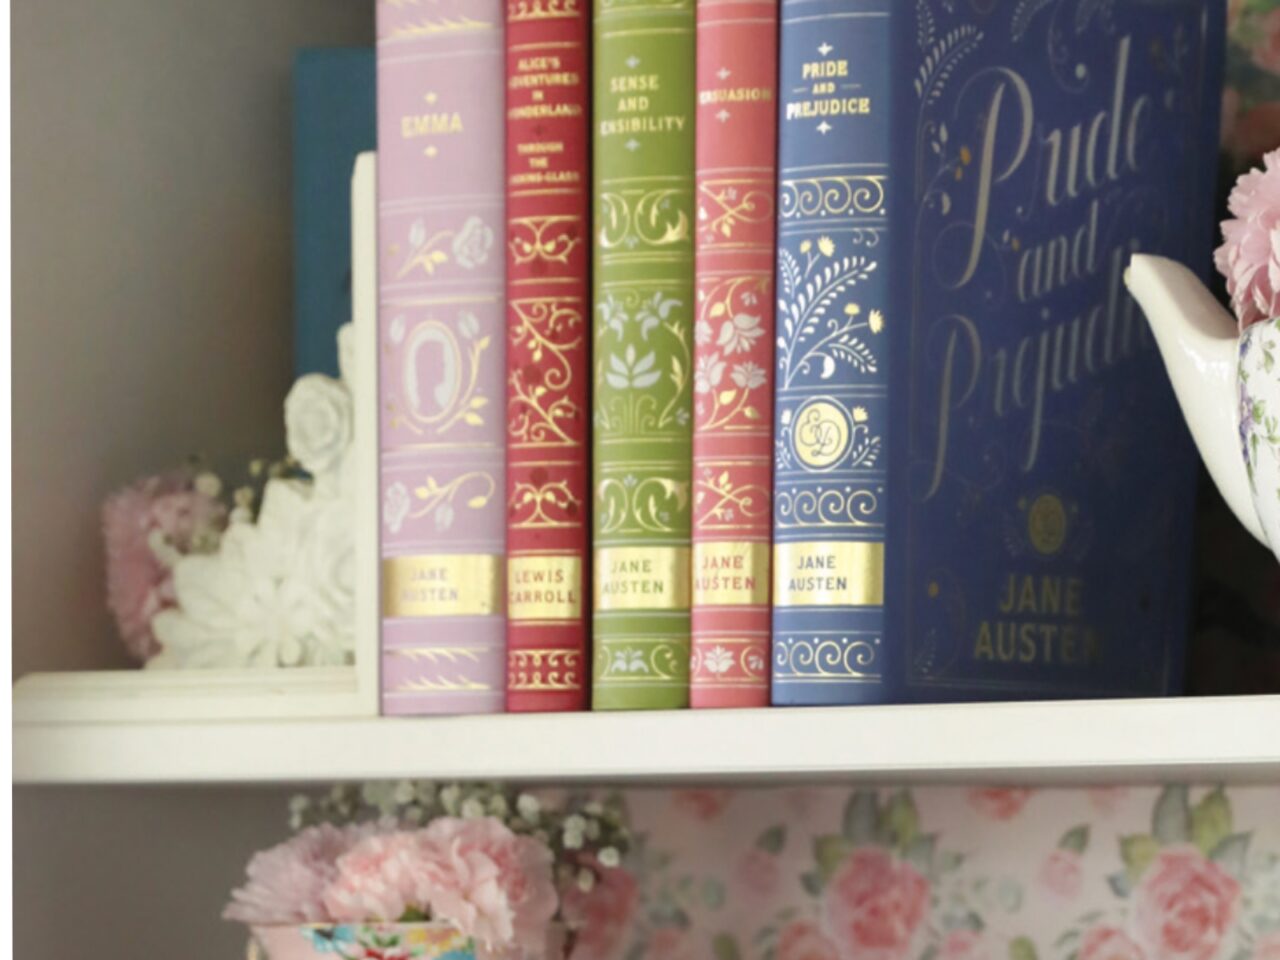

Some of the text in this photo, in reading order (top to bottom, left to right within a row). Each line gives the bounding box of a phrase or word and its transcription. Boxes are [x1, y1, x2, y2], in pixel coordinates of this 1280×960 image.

[802, 60, 848, 79] PRIDE
[610, 75, 659, 93] SENSE
[812, 81, 836, 95] AND
[617, 96, 649, 112] AND
[786, 97, 870, 120] PREJUDICE
[402, 113, 463, 138] EMMA
[600, 115, 685, 136] ENSIBILITY
[528, 156, 548, 169] THE
[953, 35, 1150, 290] Pride
[1017, 200, 1098, 302] and
[611, 559, 652, 573] JANE
[702, 555, 744, 569] JANE
[797, 555, 836, 570] JANE
[411, 568, 448, 581] JANE
[515, 569, 564, 584] LEWIS
[603, 580, 664, 595] AUSTEN
[695, 576, 756, 591] AUSTEN
[788, 576, 847, 591] AUSTEN
[999, 573, 1084, 616] JANE
[974, 619, 1104, 664] AUSTEN
